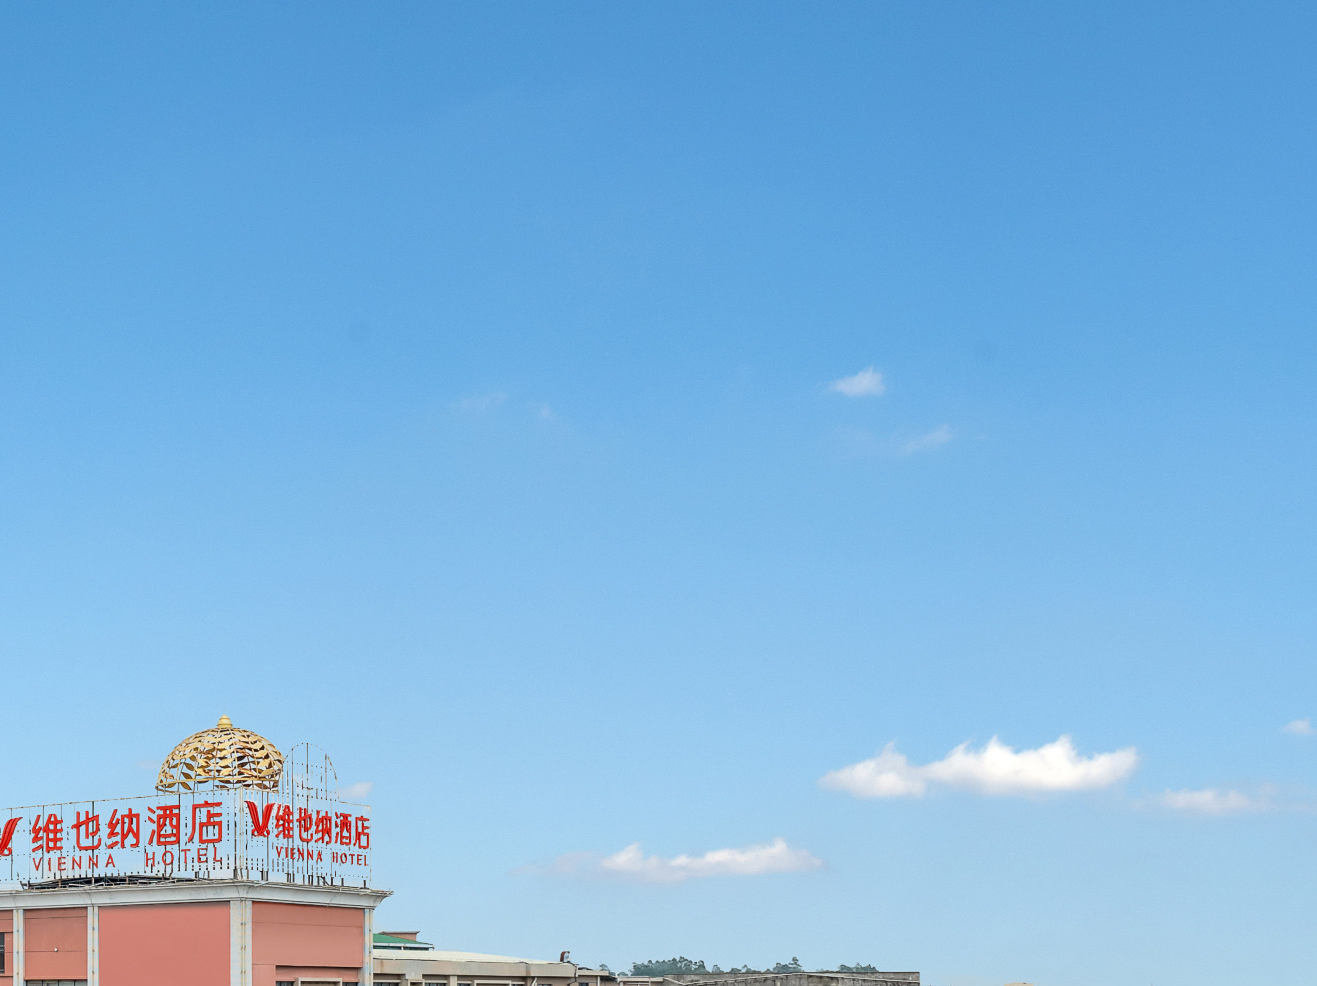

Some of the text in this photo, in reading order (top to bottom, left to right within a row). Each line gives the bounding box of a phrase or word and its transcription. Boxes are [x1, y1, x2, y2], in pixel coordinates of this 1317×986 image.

[32, 801, 223, 853] 维也纳酒店
[275, 804, 370, 850] 维也纳酒店
[33, 847, 223, 872] VIENNA HOTEL
[276, 846, 369, 867] VIENNA HOTEL
